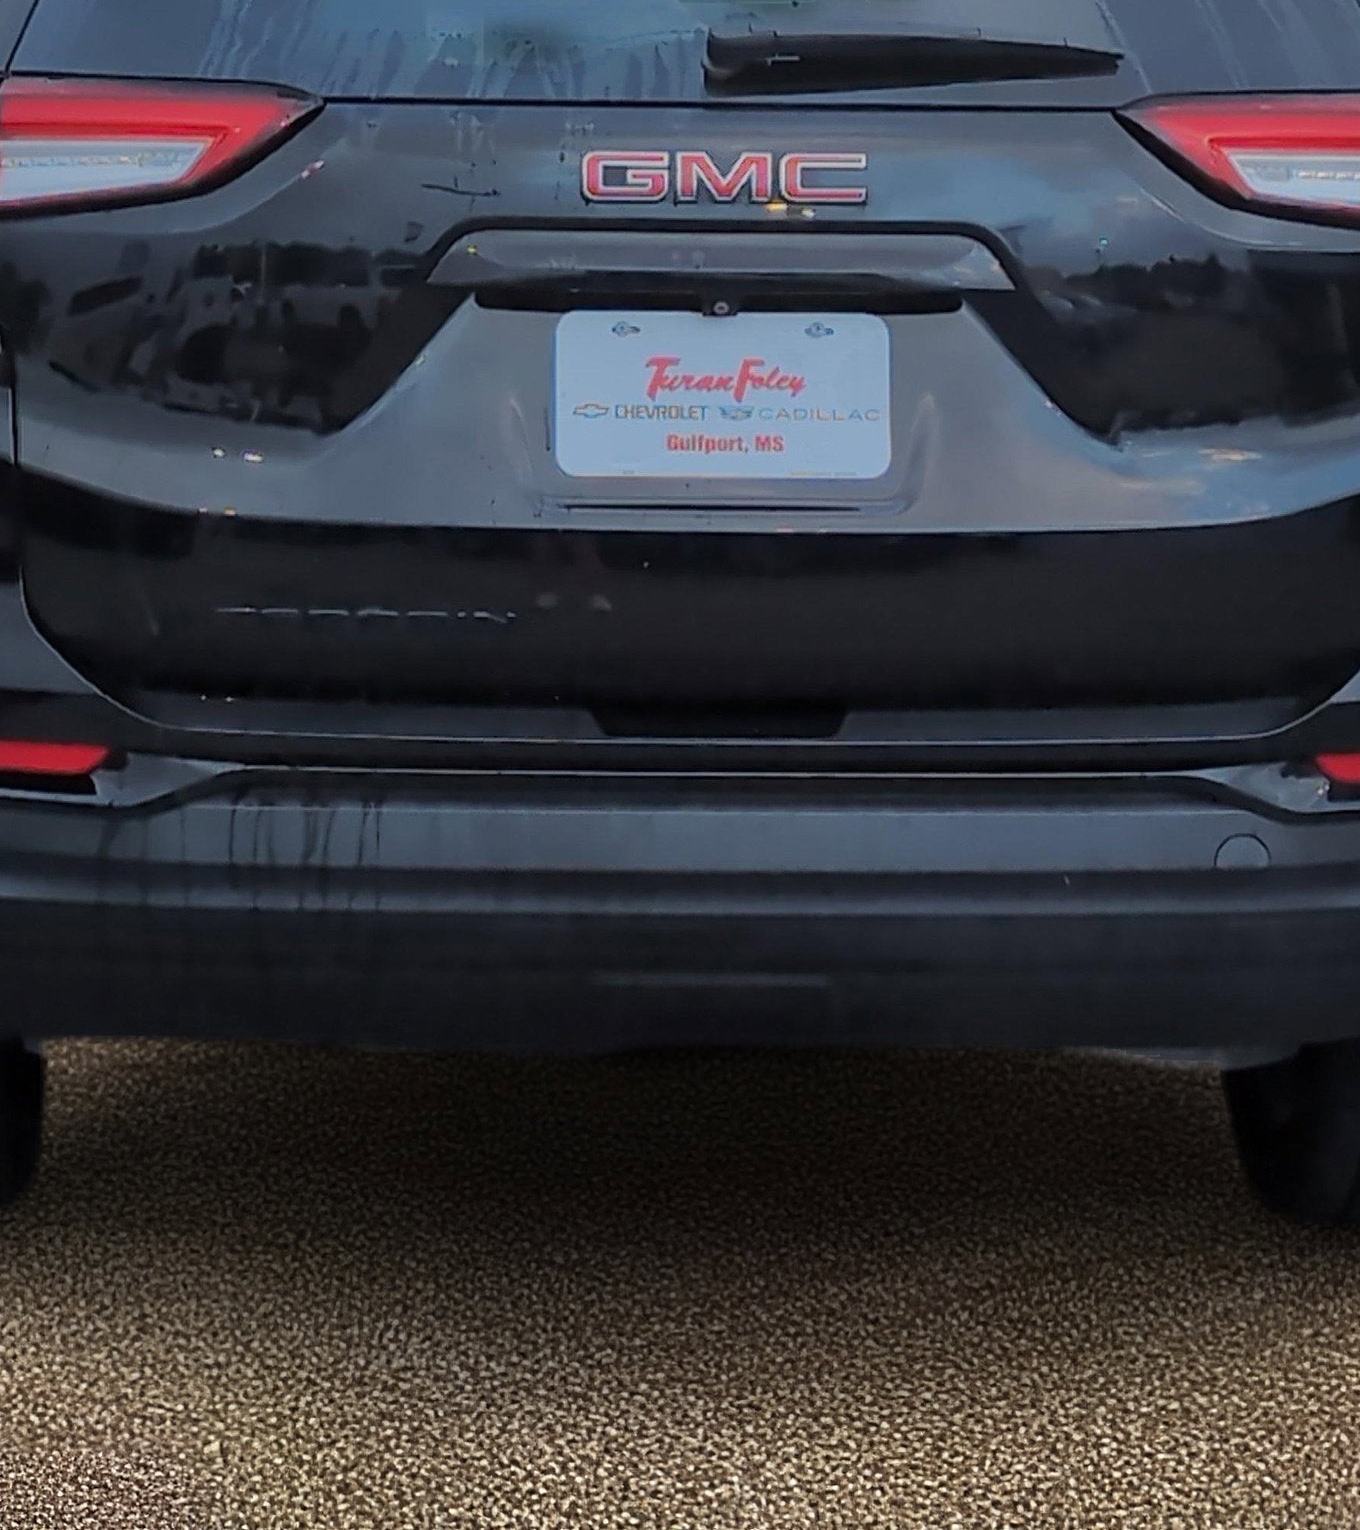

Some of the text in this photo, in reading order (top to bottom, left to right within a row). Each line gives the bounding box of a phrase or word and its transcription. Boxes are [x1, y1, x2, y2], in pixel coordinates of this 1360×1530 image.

[581, 151, 868, 204] GMC
[614, 404, 880, 422] CHEVROLET CADILLAC
[666, 433, 784, 454] Gulfport, MS
